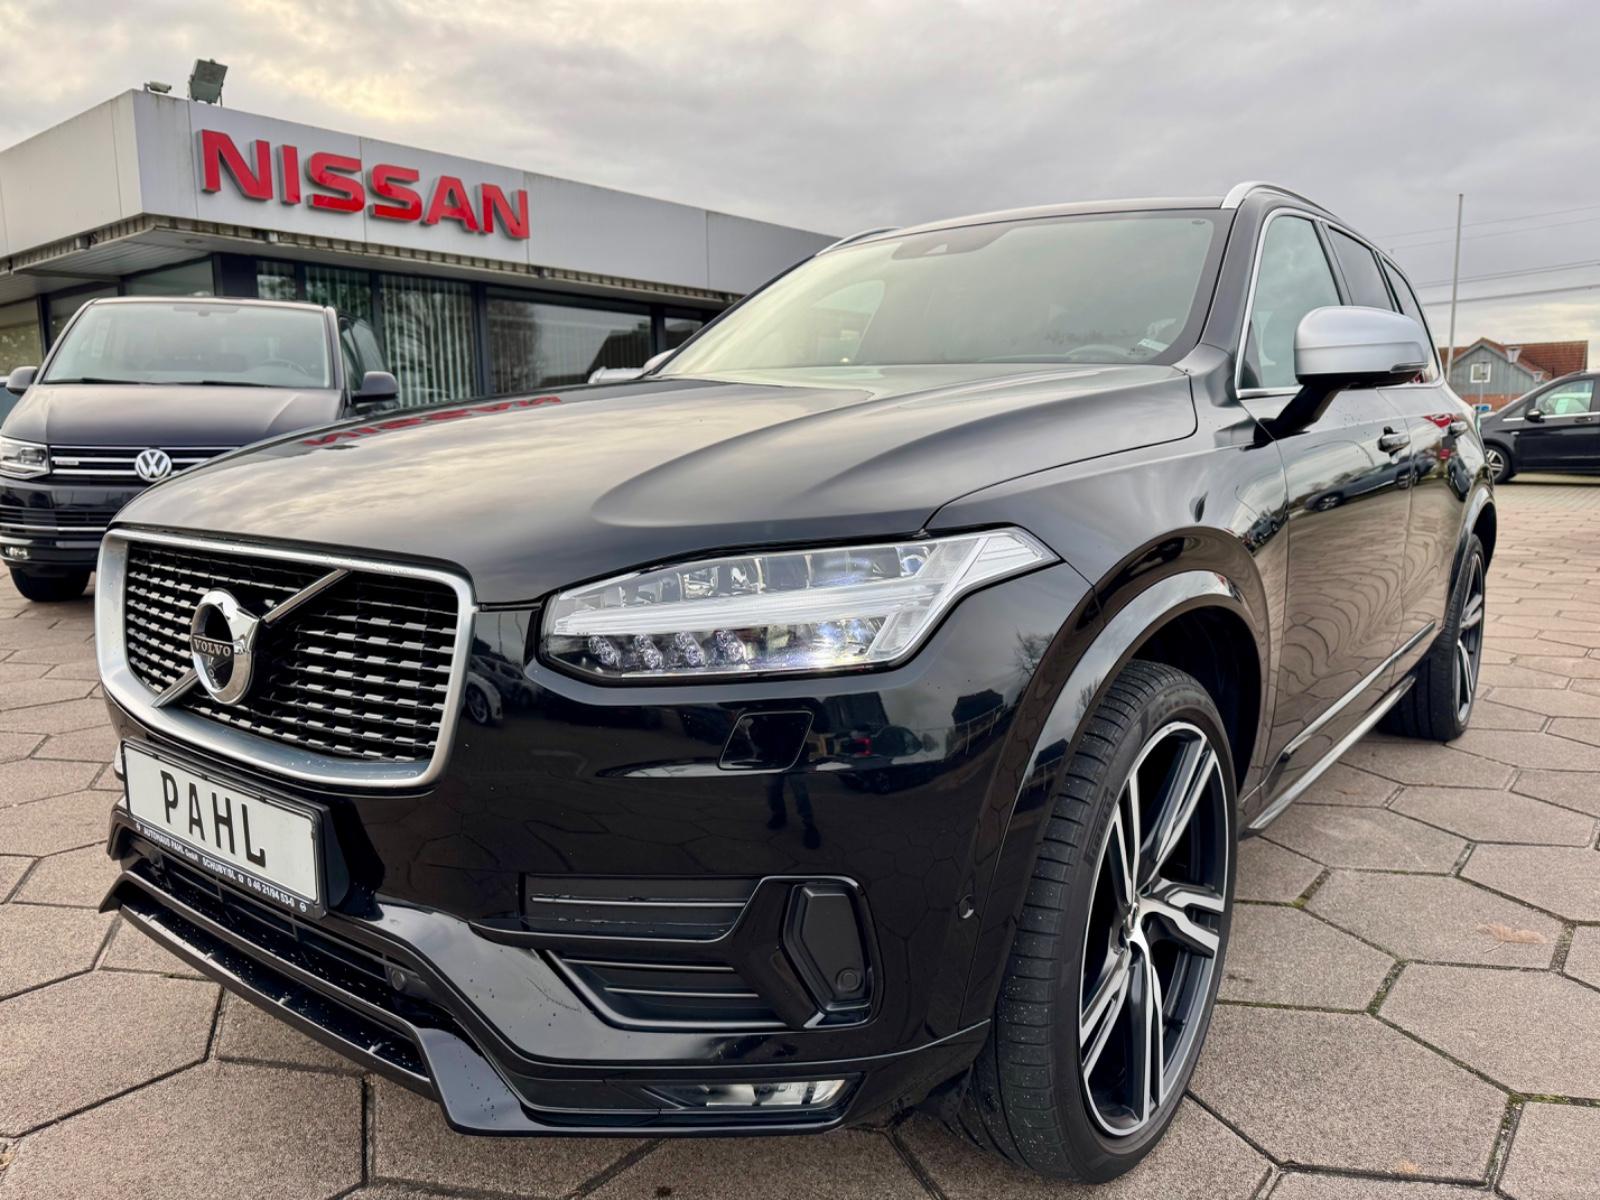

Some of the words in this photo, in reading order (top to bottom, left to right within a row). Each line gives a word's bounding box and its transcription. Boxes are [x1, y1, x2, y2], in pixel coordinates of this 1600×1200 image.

[199, 129, 530, 240] NISSAN
[194, 638, 232, 657] VOLVO
[160, 769, 267, 868] PAHL
